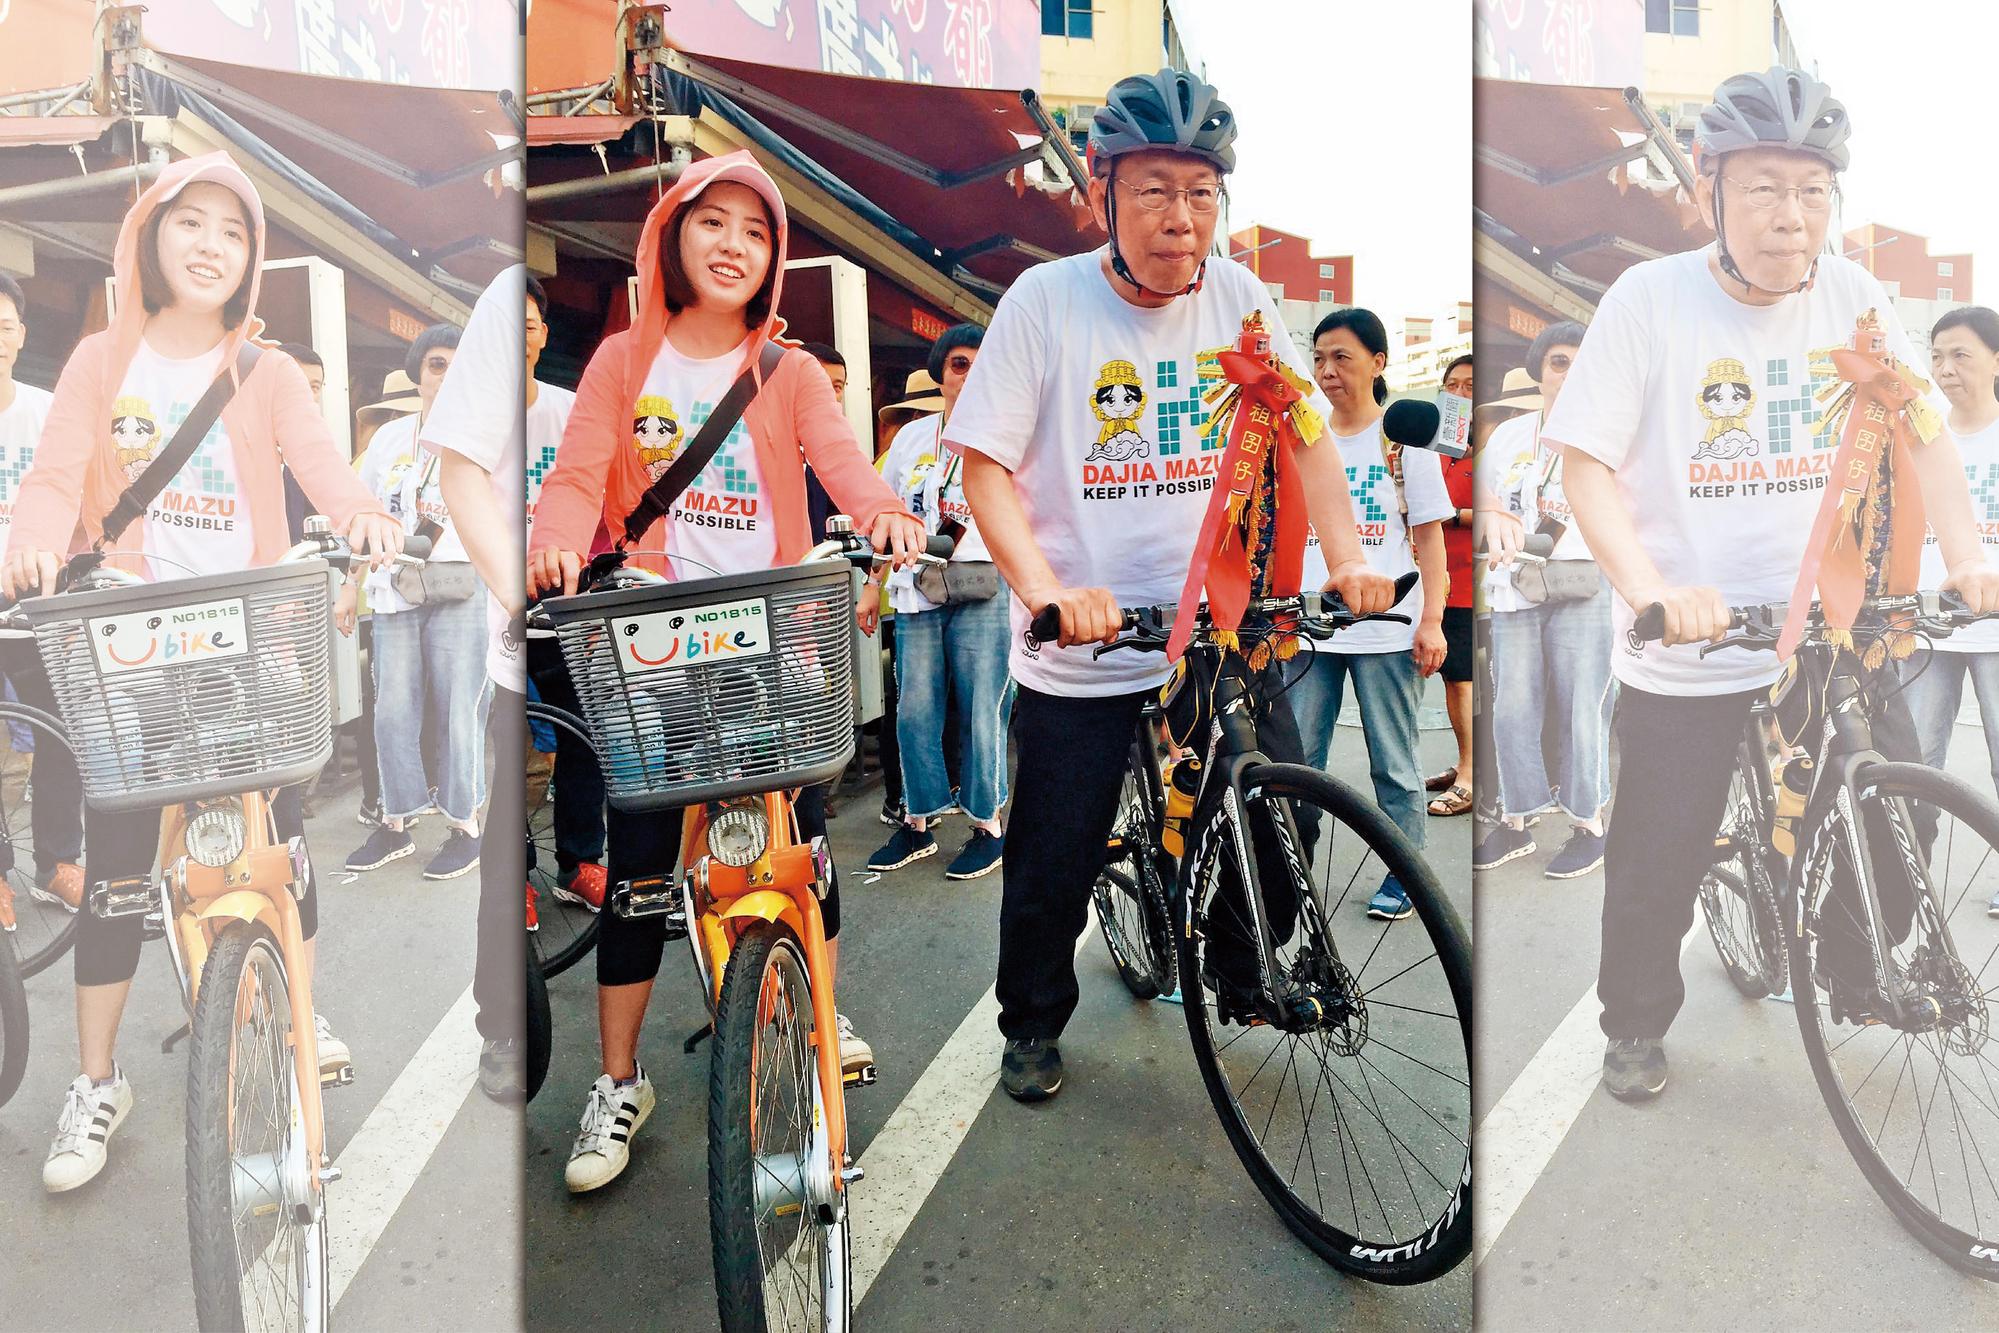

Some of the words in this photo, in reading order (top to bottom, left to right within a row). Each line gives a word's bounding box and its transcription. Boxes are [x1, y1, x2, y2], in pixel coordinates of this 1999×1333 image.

[1083, 462, 1158, 485] DAJIA
[1689, 461, 1768, 483] DAJIA
[1083, 487, 1127, 500] KEEP
[1134, 485, 1149, 498] IT
[1689, 485, 1735, 498] KEEP
[1742, 483, 1759, 496] IT
[162, 491, 236, 517] MAZU
[685, 491, 757, 516] MAZU
[152, 510, 235, 531] POSSIBLE
[674, 510, 756, 531] POSSIBLE
[1355, 523, 1386, 537] AZU
[695, 605, 762, 624] NO1815
